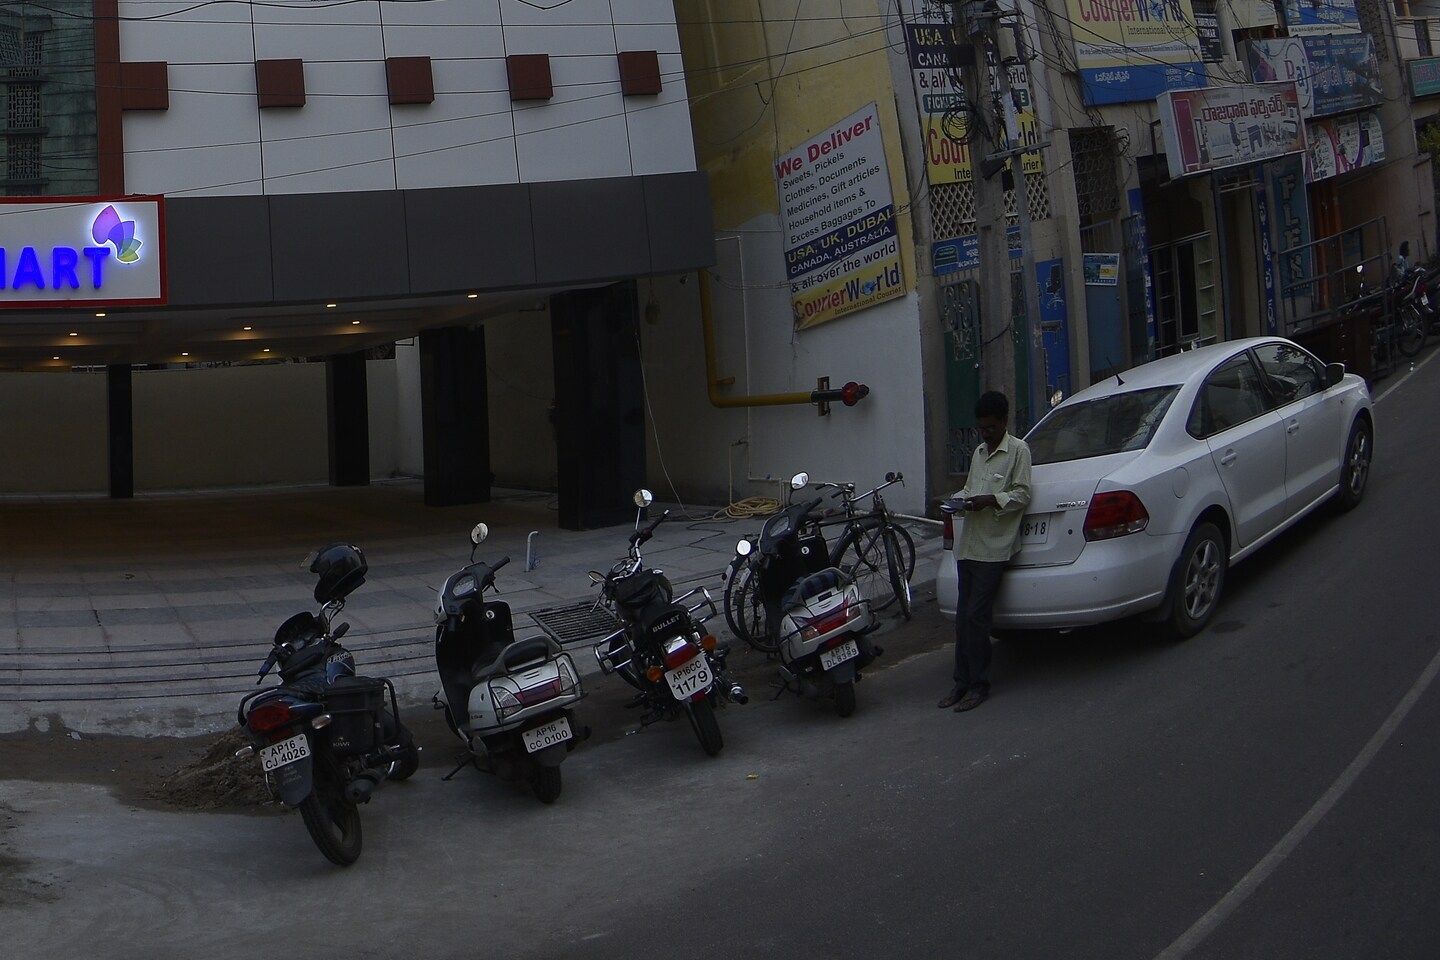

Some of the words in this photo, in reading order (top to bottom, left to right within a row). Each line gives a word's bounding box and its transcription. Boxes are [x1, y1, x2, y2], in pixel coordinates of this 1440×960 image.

[1127, 26, 1166, 35] International
[1201, 101, 1248, 122] రాజధాని
[776, 156, 803, 180] We
[807, 113, 874, 163] Deliver
[783, 169, 813, 190] Sweets,
[815, 151, 845, 173] Pickels
[785, 182, 817, 203] Clothes,
[819, 155, 867, 186] Documents
[787, 193, 830, 217] Medicines,
[831, 181, 846, 196] Gift
[849, 164, 880, 187] articles
[788, 204, 832, 231] Household
[833, 193, 857, 214] items
[859, 187, 866, 198] &
[791, 228, 819, 245] Excess
[821, 206, 863, 235] Baggages
[865, 199, 876, 211] To
[788, 243, 818, 263] USA,
[820, 231, 843, 251] UK,
[847, 209, 891, 238] DUBAI
[790, 253, 832, 274] CANADA,
[834, 225, 890, 256] AUSTRALIA
[791, 282, 800, 293] &
[802, 277, 814, 290] all
[817, 267, 841, 284] over
[843, 256, 861, 274] the
[863, 241, 896, 264] world
[835, 296, 876, 315] International
[877, 286, 901, 304] Courier
[652, 614, 680, 633] BULLET
[672, 660, 702, 682] AP16CC
[676, 670, 708, 695] 1179
[529, 740, 543, 750] CC
[544, 730, 568, 745] 0100
[536, 725, 557, 737] AP16
[265, 757, 279, 769] CJ
[281, 747, 306, 763] 4026
[271, 740, 296, 757] AP16
